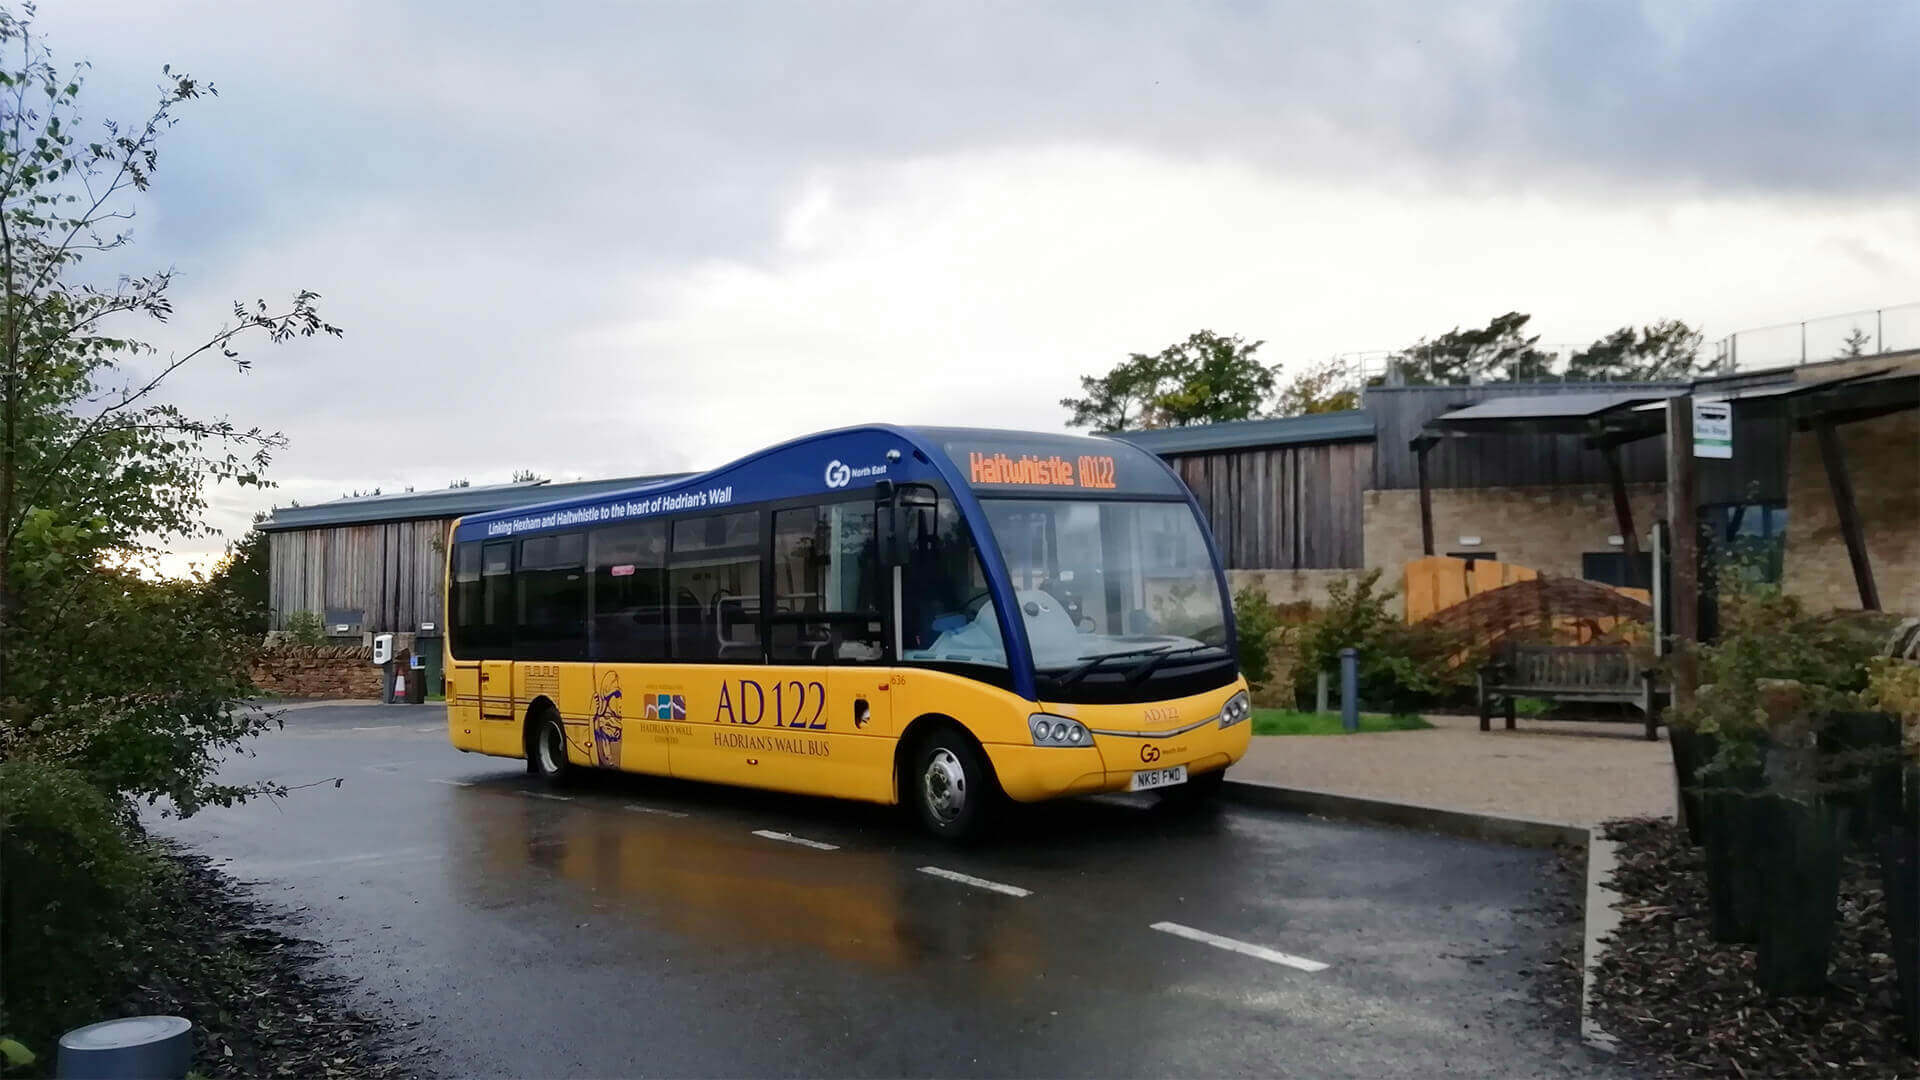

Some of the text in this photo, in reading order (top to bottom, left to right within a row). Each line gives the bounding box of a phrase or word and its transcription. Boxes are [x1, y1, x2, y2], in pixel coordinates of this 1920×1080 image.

[851, 467, 871, 478] North
[871, 464, 887, 476] East
[970, 452, 1075, 485] Haltwhistle
[488, 486, 732, 535] Linking Hexham and Haltwhistle to the heart of Hadrian's Wall
[891, 674, 906, 686] 636
[675, 726, 694, 737] WALL
[713, 732, 831, 758] HADRIAN'S WALL BUS
[1137, 771, 1160, 788] NK61
